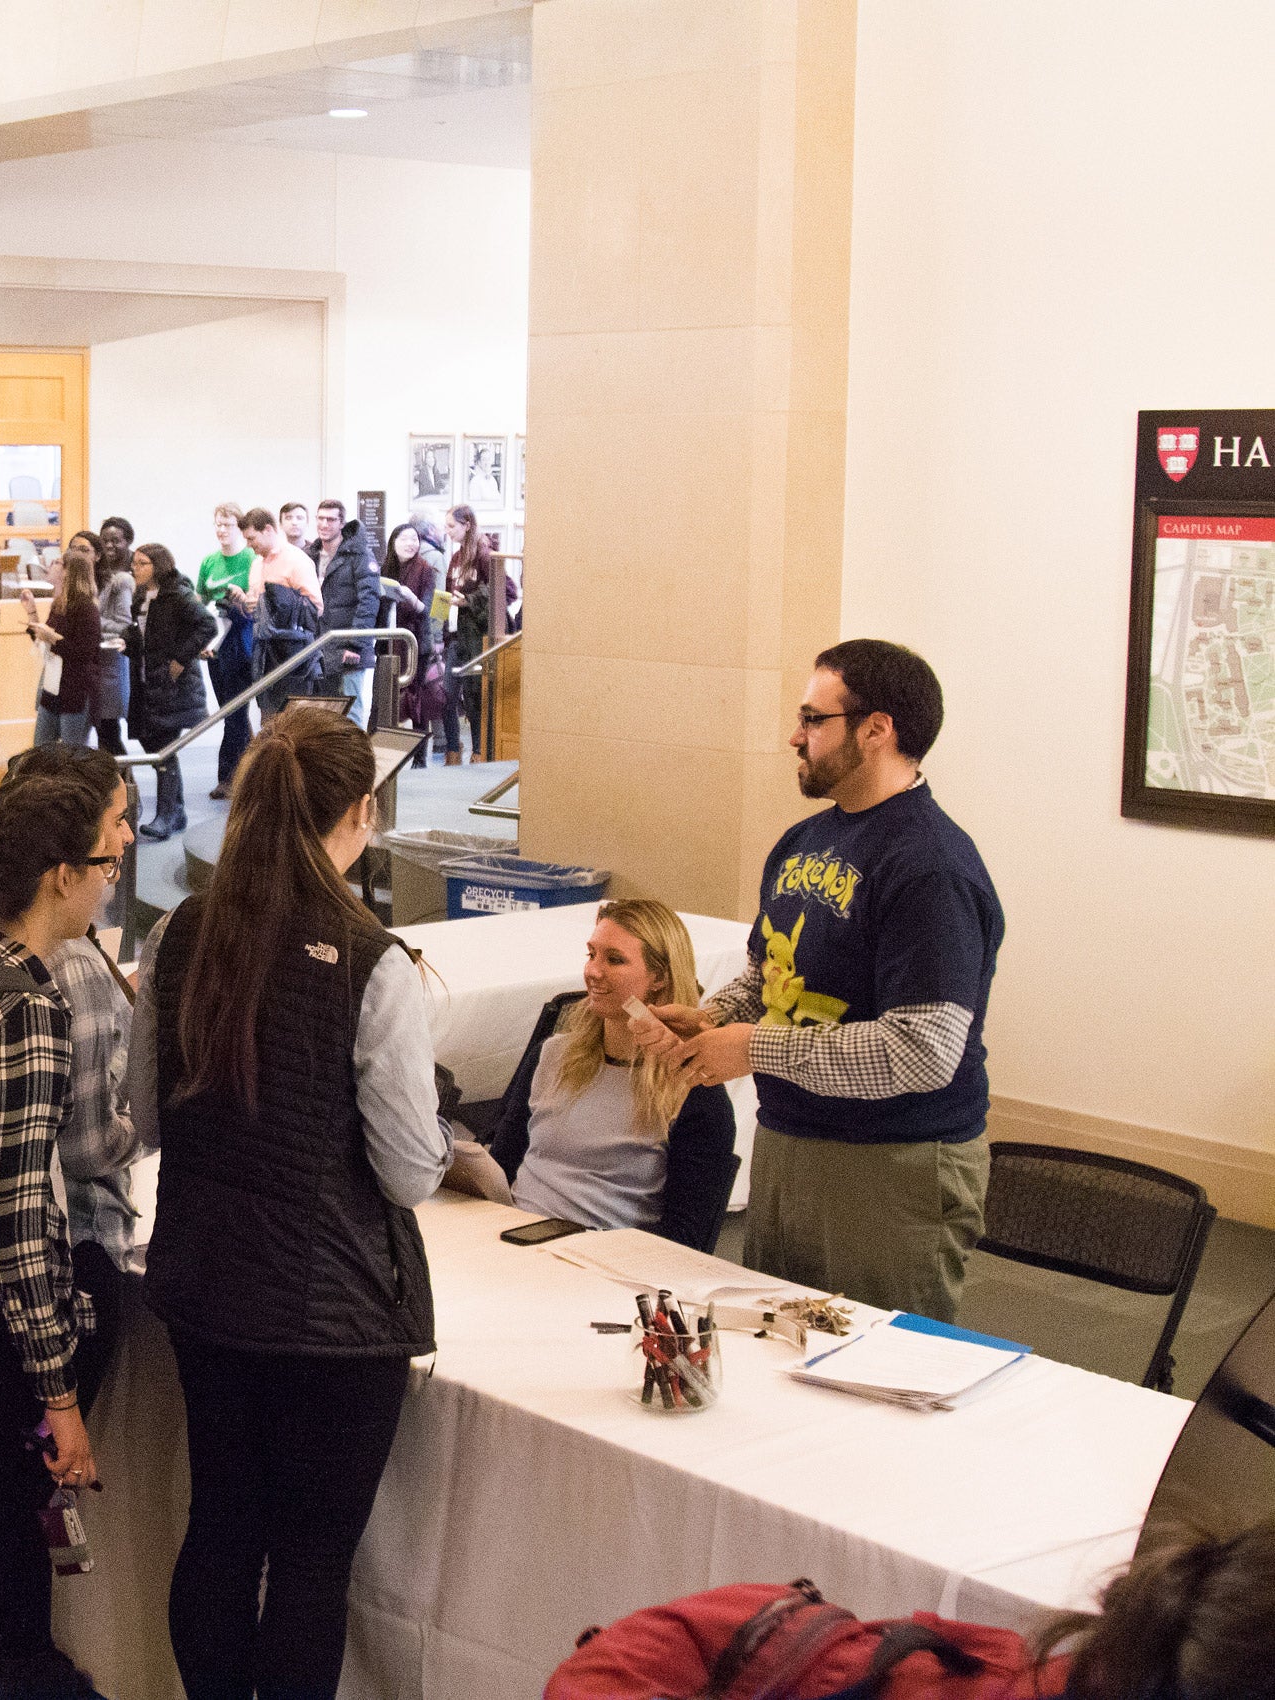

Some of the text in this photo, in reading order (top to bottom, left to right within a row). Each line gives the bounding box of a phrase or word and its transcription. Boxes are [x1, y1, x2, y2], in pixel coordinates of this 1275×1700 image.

[1213, 436, 1272, 467] HA
[1163, 523, 1242, 536] CAMPUS MAP
[472, 886, 515, 901] RECYCLE
